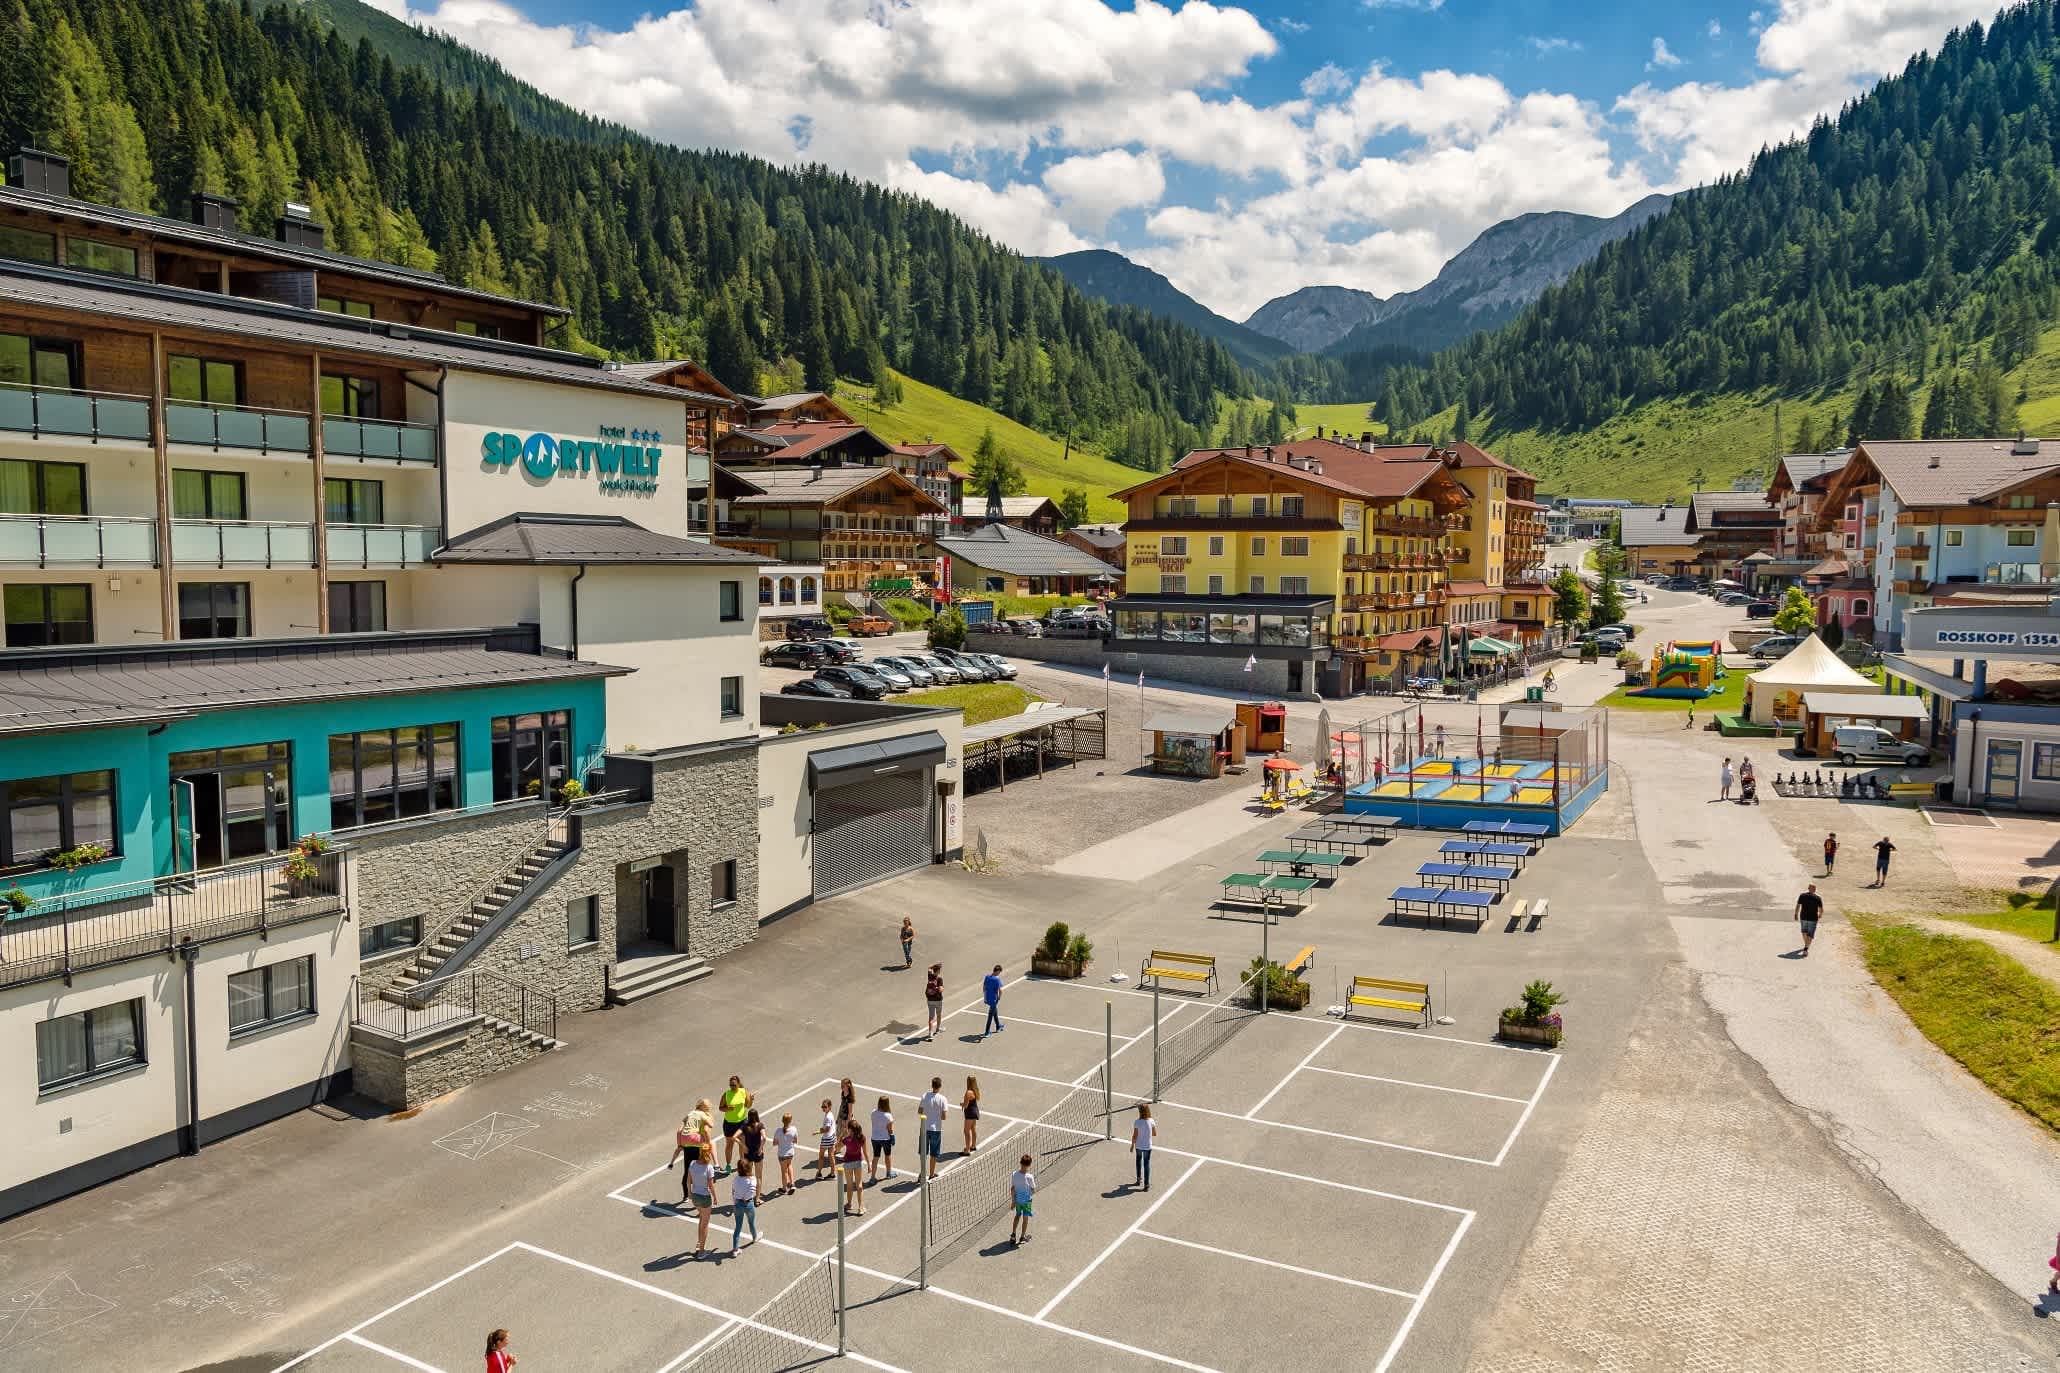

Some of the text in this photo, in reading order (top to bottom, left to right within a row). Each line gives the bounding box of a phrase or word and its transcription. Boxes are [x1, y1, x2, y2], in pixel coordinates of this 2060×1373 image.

[600, 424, 625, 439] hotel
[483, 431, 662, 479] SPORTWELT
[1937, 631, 2059, 646] ROSSKOPF 1354
